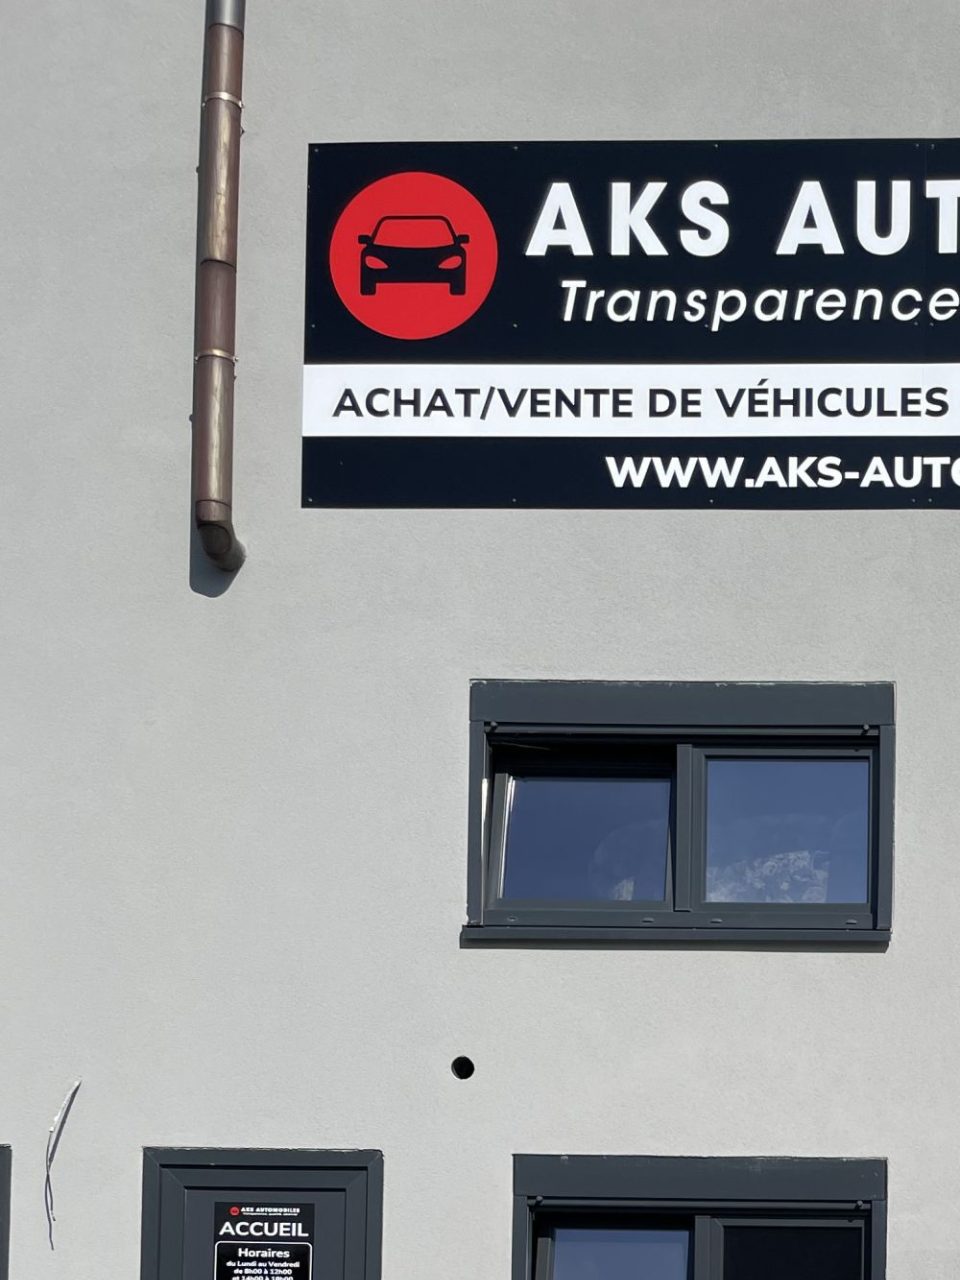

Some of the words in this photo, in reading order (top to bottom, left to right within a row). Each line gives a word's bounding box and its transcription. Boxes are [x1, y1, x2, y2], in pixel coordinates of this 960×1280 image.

[526, 181, 729, 256] AKS
[333, 387, 632, 419] ACHAT/VENTE
[649, 389, 701, 417] DE
[715, 379, 948, 417] VÉHICULES
[219, 1222, 309, 1237] ACCUEIL
[238, 1248, 290, 1258] Horaires
